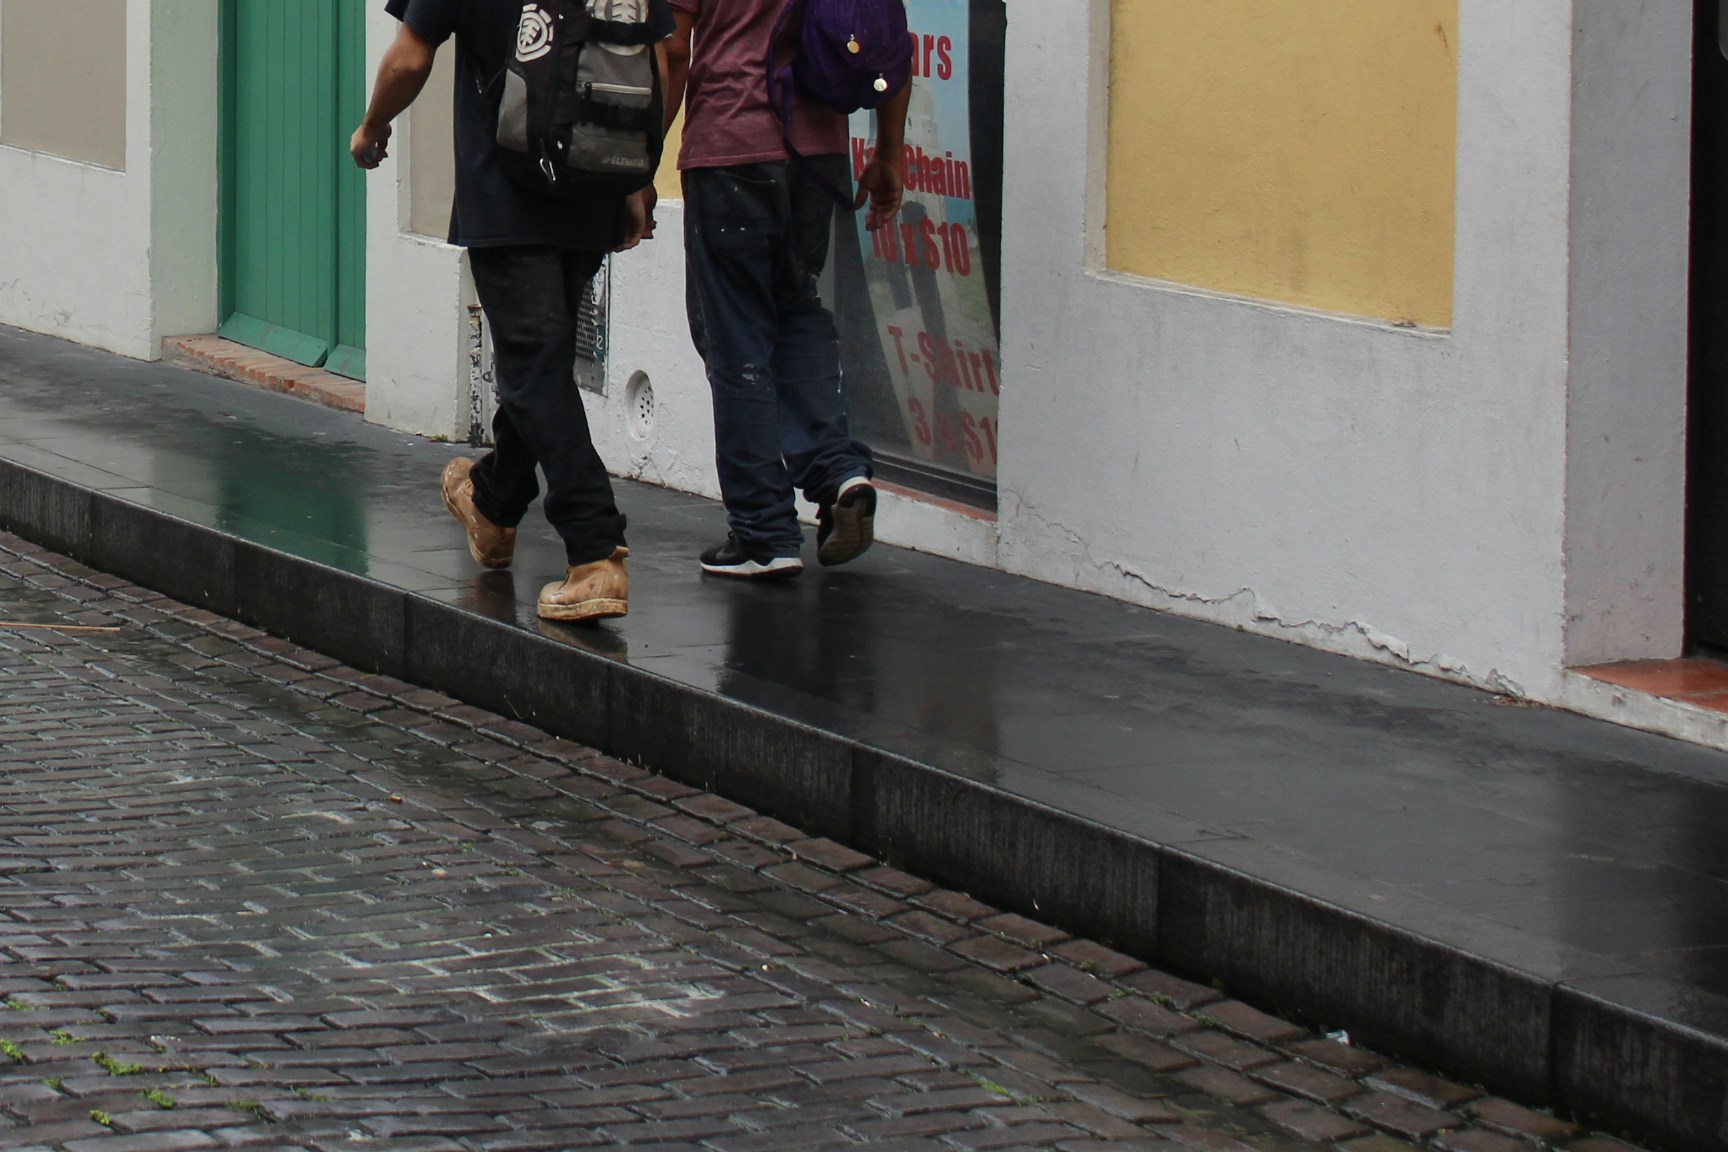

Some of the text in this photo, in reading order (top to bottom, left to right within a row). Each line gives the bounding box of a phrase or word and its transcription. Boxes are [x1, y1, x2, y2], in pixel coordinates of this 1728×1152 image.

[902, 144, 970, 200] Chain
[899, 223, 920, 266] x
[919, 214, 971, 277] $10
[908, 396, 932, 447] 3
[959, 408, 998, 466] $1
